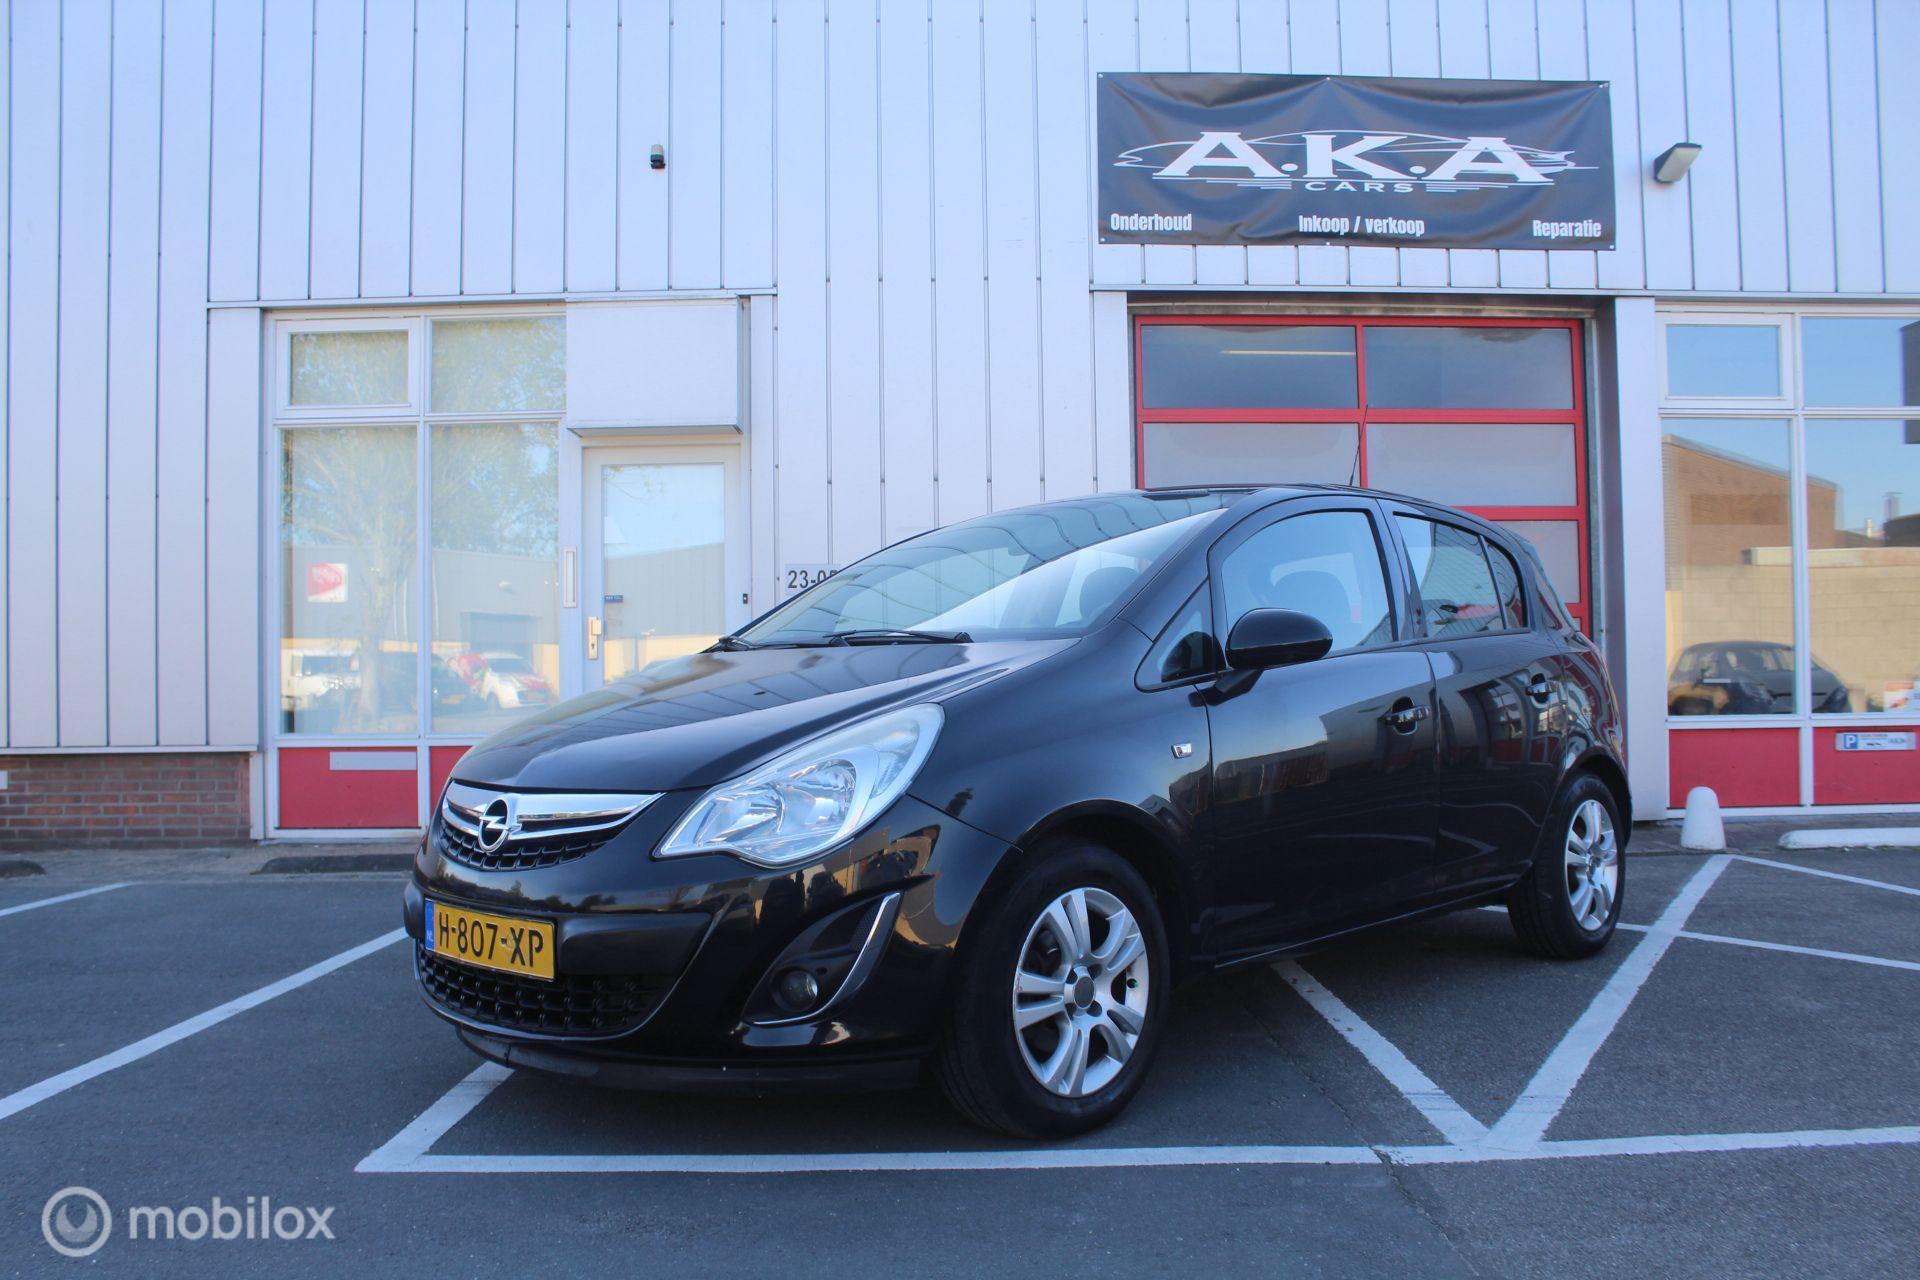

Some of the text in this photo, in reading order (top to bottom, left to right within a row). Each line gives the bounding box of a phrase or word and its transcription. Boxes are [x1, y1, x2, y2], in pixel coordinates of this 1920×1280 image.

[1152, 131, 1554, 182] A.K.A
[1304, 181, 1414, 193] CARS
[1110, 212, 1193, 231] Onderhoud
[1298, 215, 1425, 237] Inkoop / verkoop
[1532, 219, 1602, 239] Reparatie
[787, 569, 838, 589] 23-0
[438, 911, 544, 968] H-807-XP
